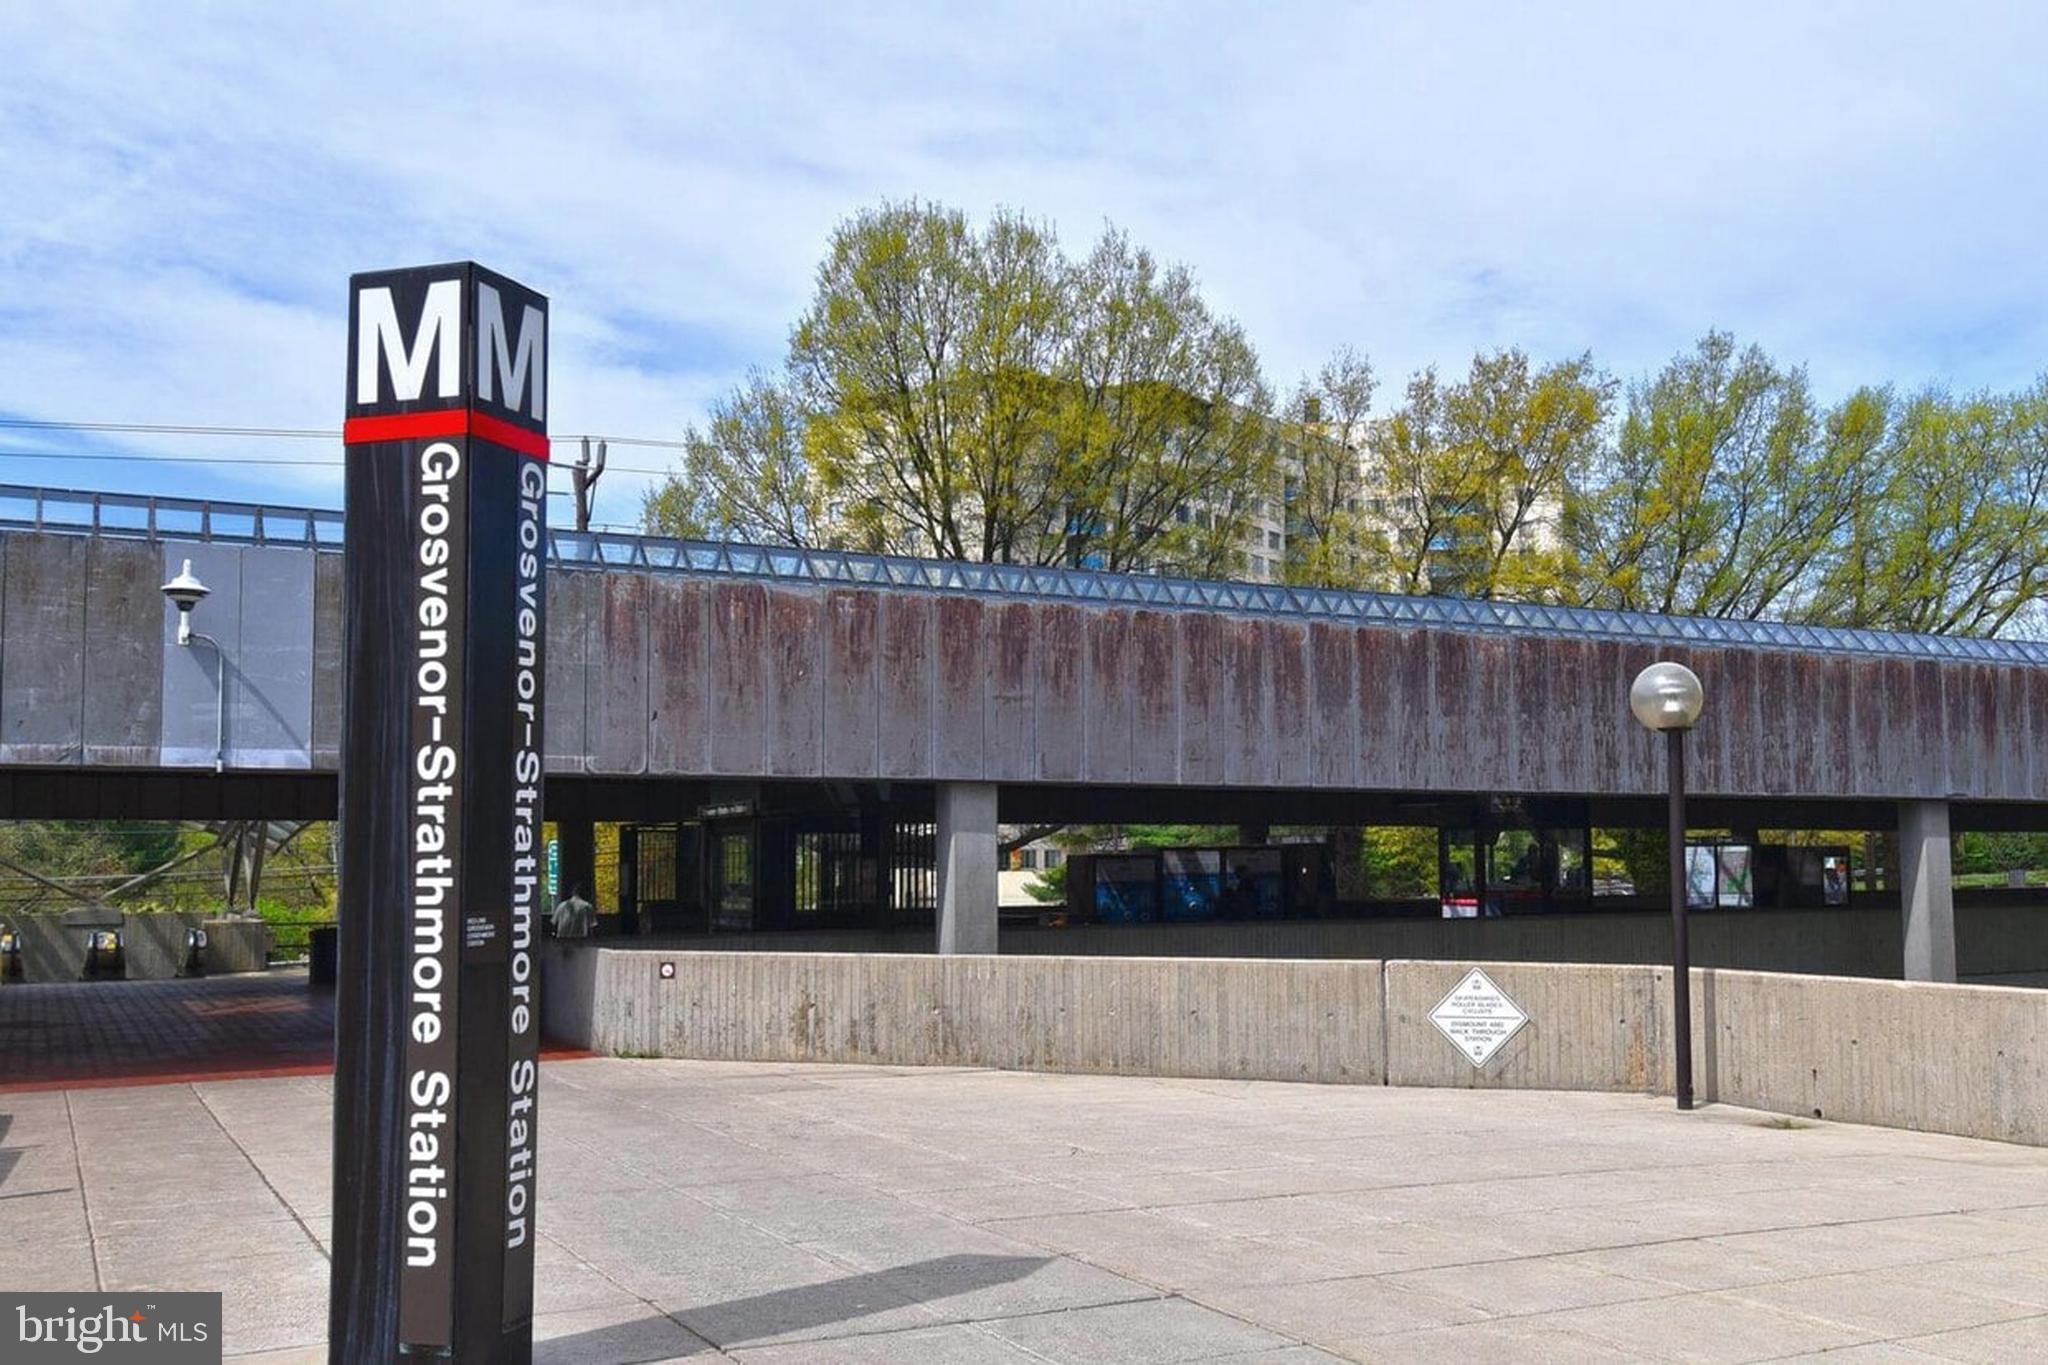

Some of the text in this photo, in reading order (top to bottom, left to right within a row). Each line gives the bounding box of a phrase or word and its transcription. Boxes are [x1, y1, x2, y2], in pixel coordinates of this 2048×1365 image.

[357, 279, 461, 405] M
[478, 281, 545, 422] M
[407, 442, 460, 1267] Grosvenor-Strathmore Station
[507, 462, 544, 1249] Grosvenor-Strathmore Station
